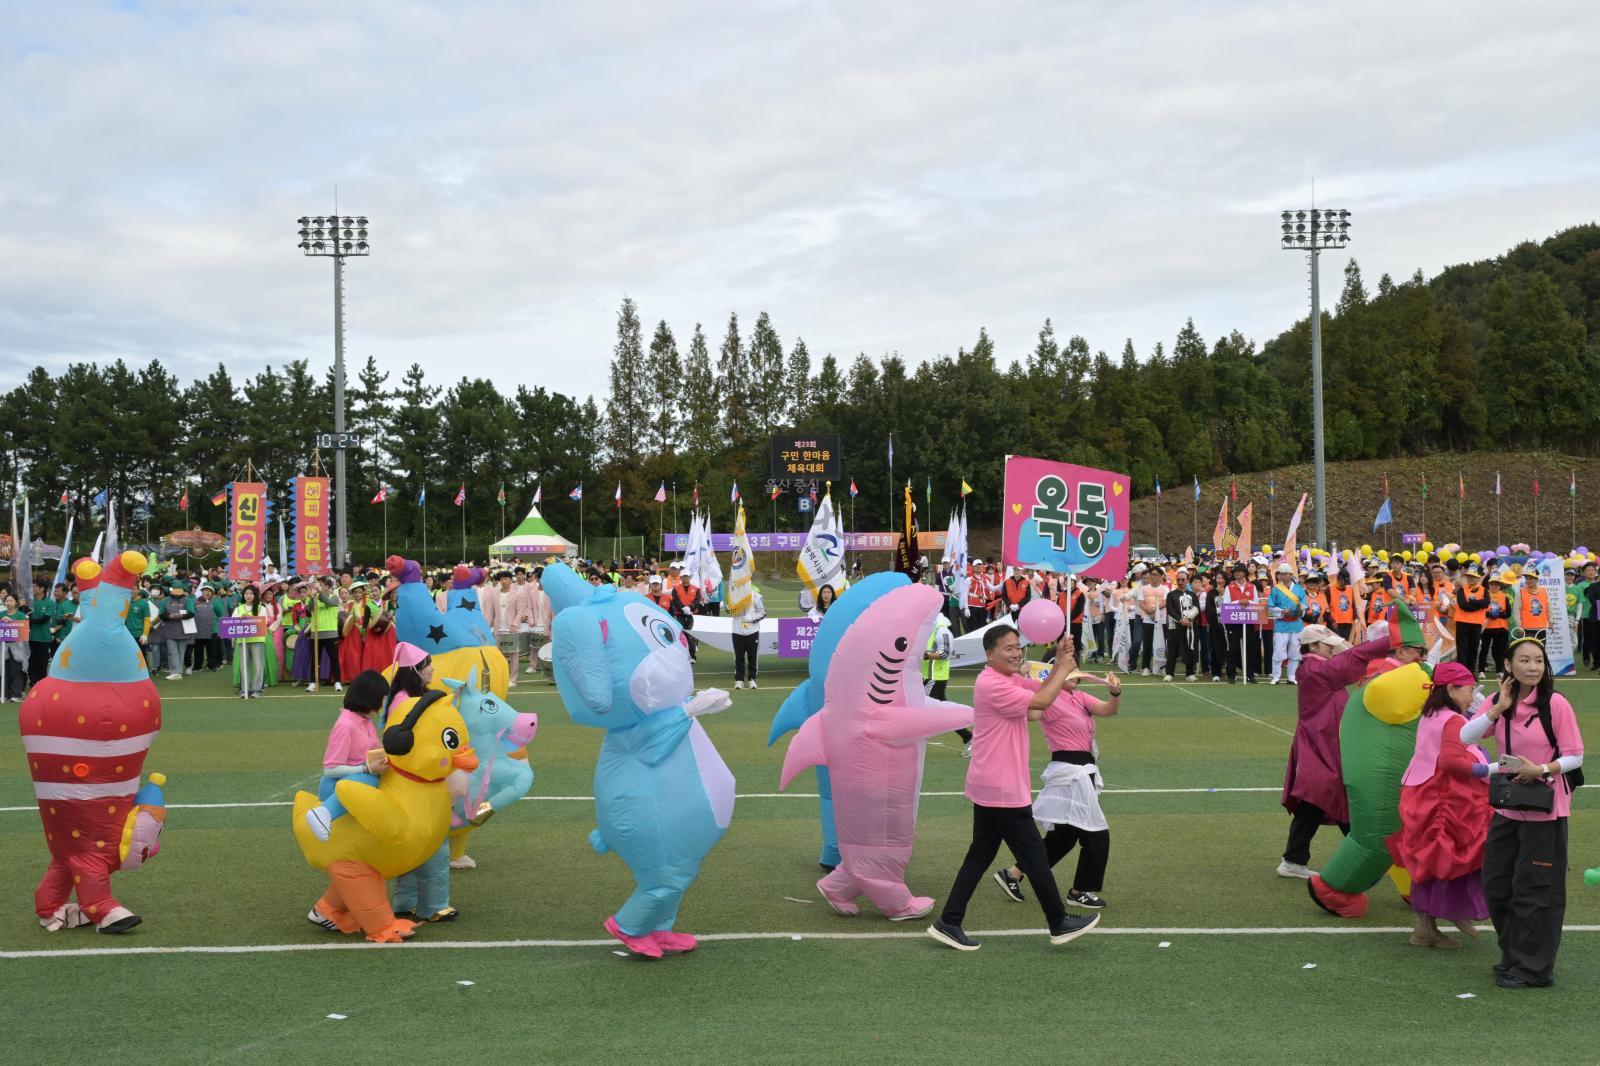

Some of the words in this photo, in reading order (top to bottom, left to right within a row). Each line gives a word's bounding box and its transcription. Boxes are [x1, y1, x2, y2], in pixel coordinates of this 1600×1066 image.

[316, 433, 331, 448] 10
[338, 433, 360, 448] 24
[794, 440, 816, 449] 제23회
[781, 450, 799, 461] 구민
[802, 450, 831, 461] 한마음
[787, 463, 824, 473] 체육대회
[800, 499, 810, 511] B
[1032, 474, 1108, 557] 옥동
[778, 535, 801, 547] 구민
[1231, 611, 1258, 621] 신정1동
[228, 624, 258, 635] 신정2동
